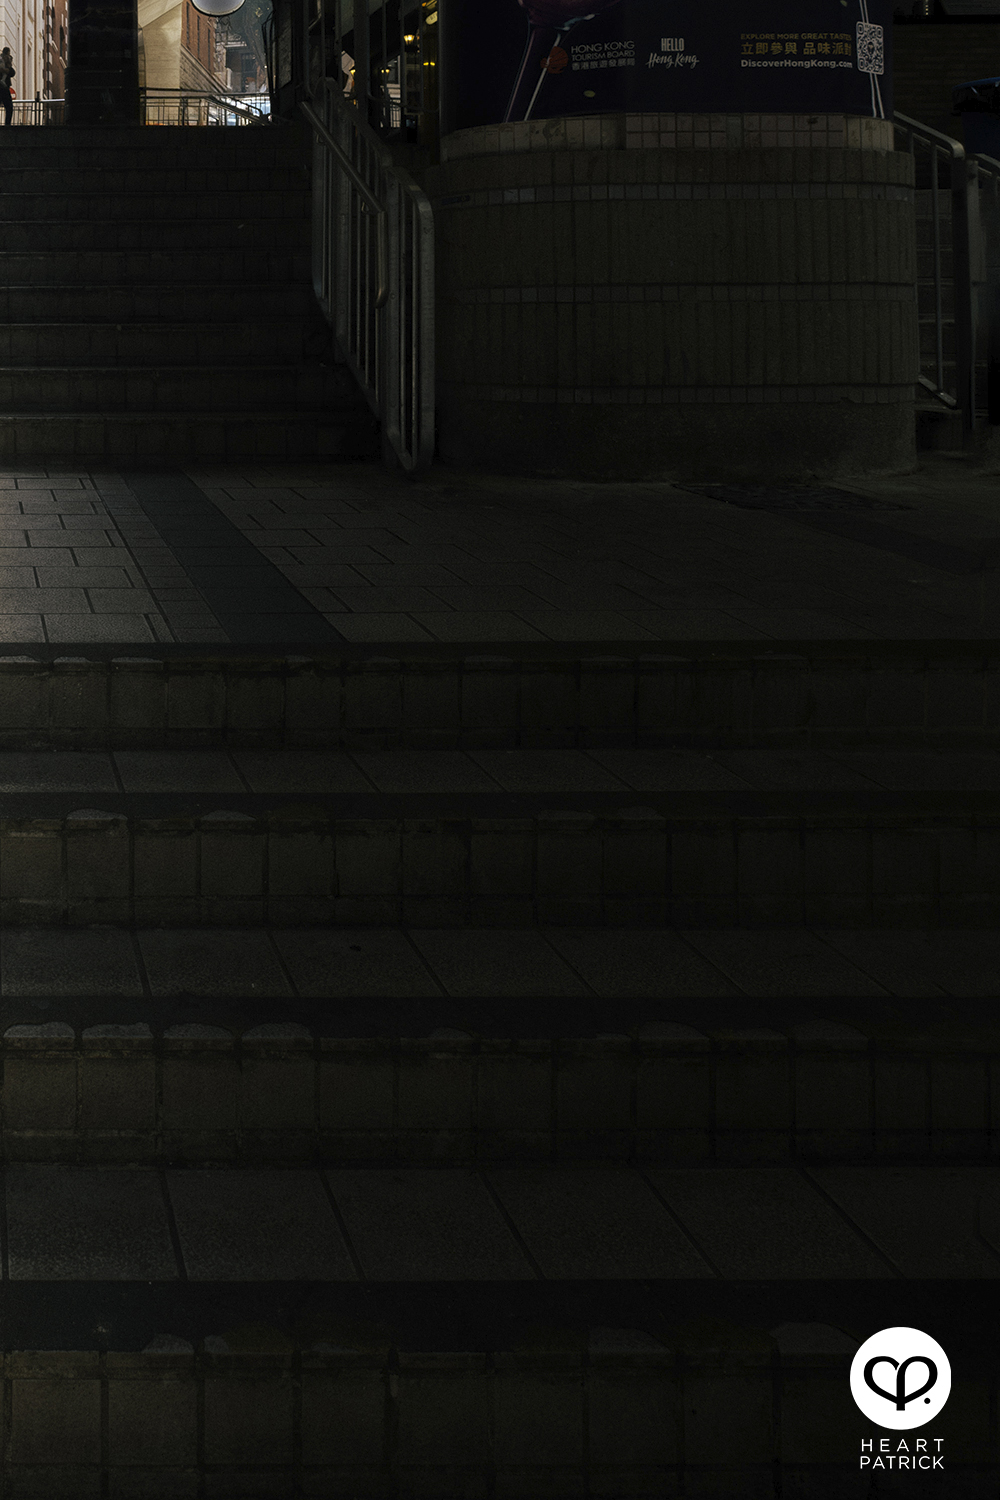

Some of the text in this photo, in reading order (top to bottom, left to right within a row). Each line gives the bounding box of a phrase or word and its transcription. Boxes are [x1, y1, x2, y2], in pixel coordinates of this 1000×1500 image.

[830, 33, 852, 41] TASTES
[570, 40, 635, 54] HONG KONG
[660, 37, 685, 52] HELLO
[571, 50, 636, 62] TOURISM BOARD
[645, 52, 700, 69] Hong Kong
[740, 59, 853, 69] DiscoverHongKong.com
